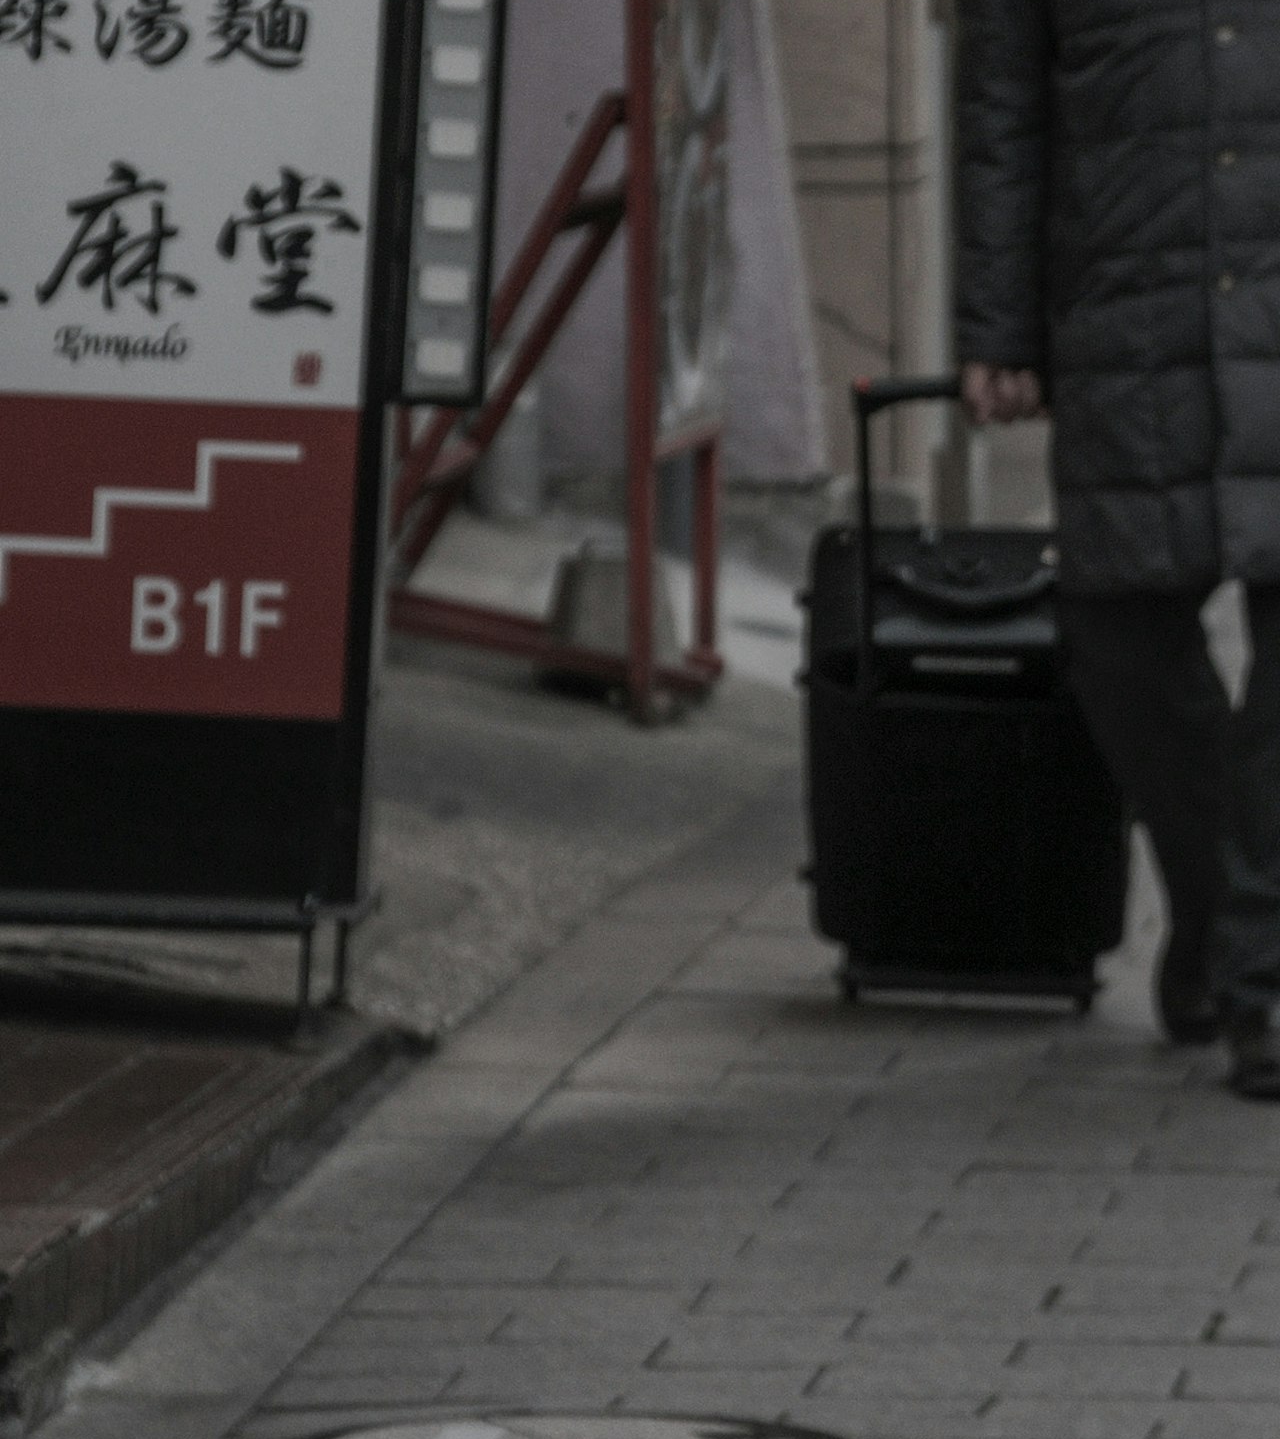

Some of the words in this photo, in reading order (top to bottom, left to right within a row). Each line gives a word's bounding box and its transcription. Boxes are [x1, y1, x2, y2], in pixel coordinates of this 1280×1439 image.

[0, 160, 363, 317] 麻堂
[54, 322, 192, 366] Enmado
[130, 577, 287, 660] B1F
